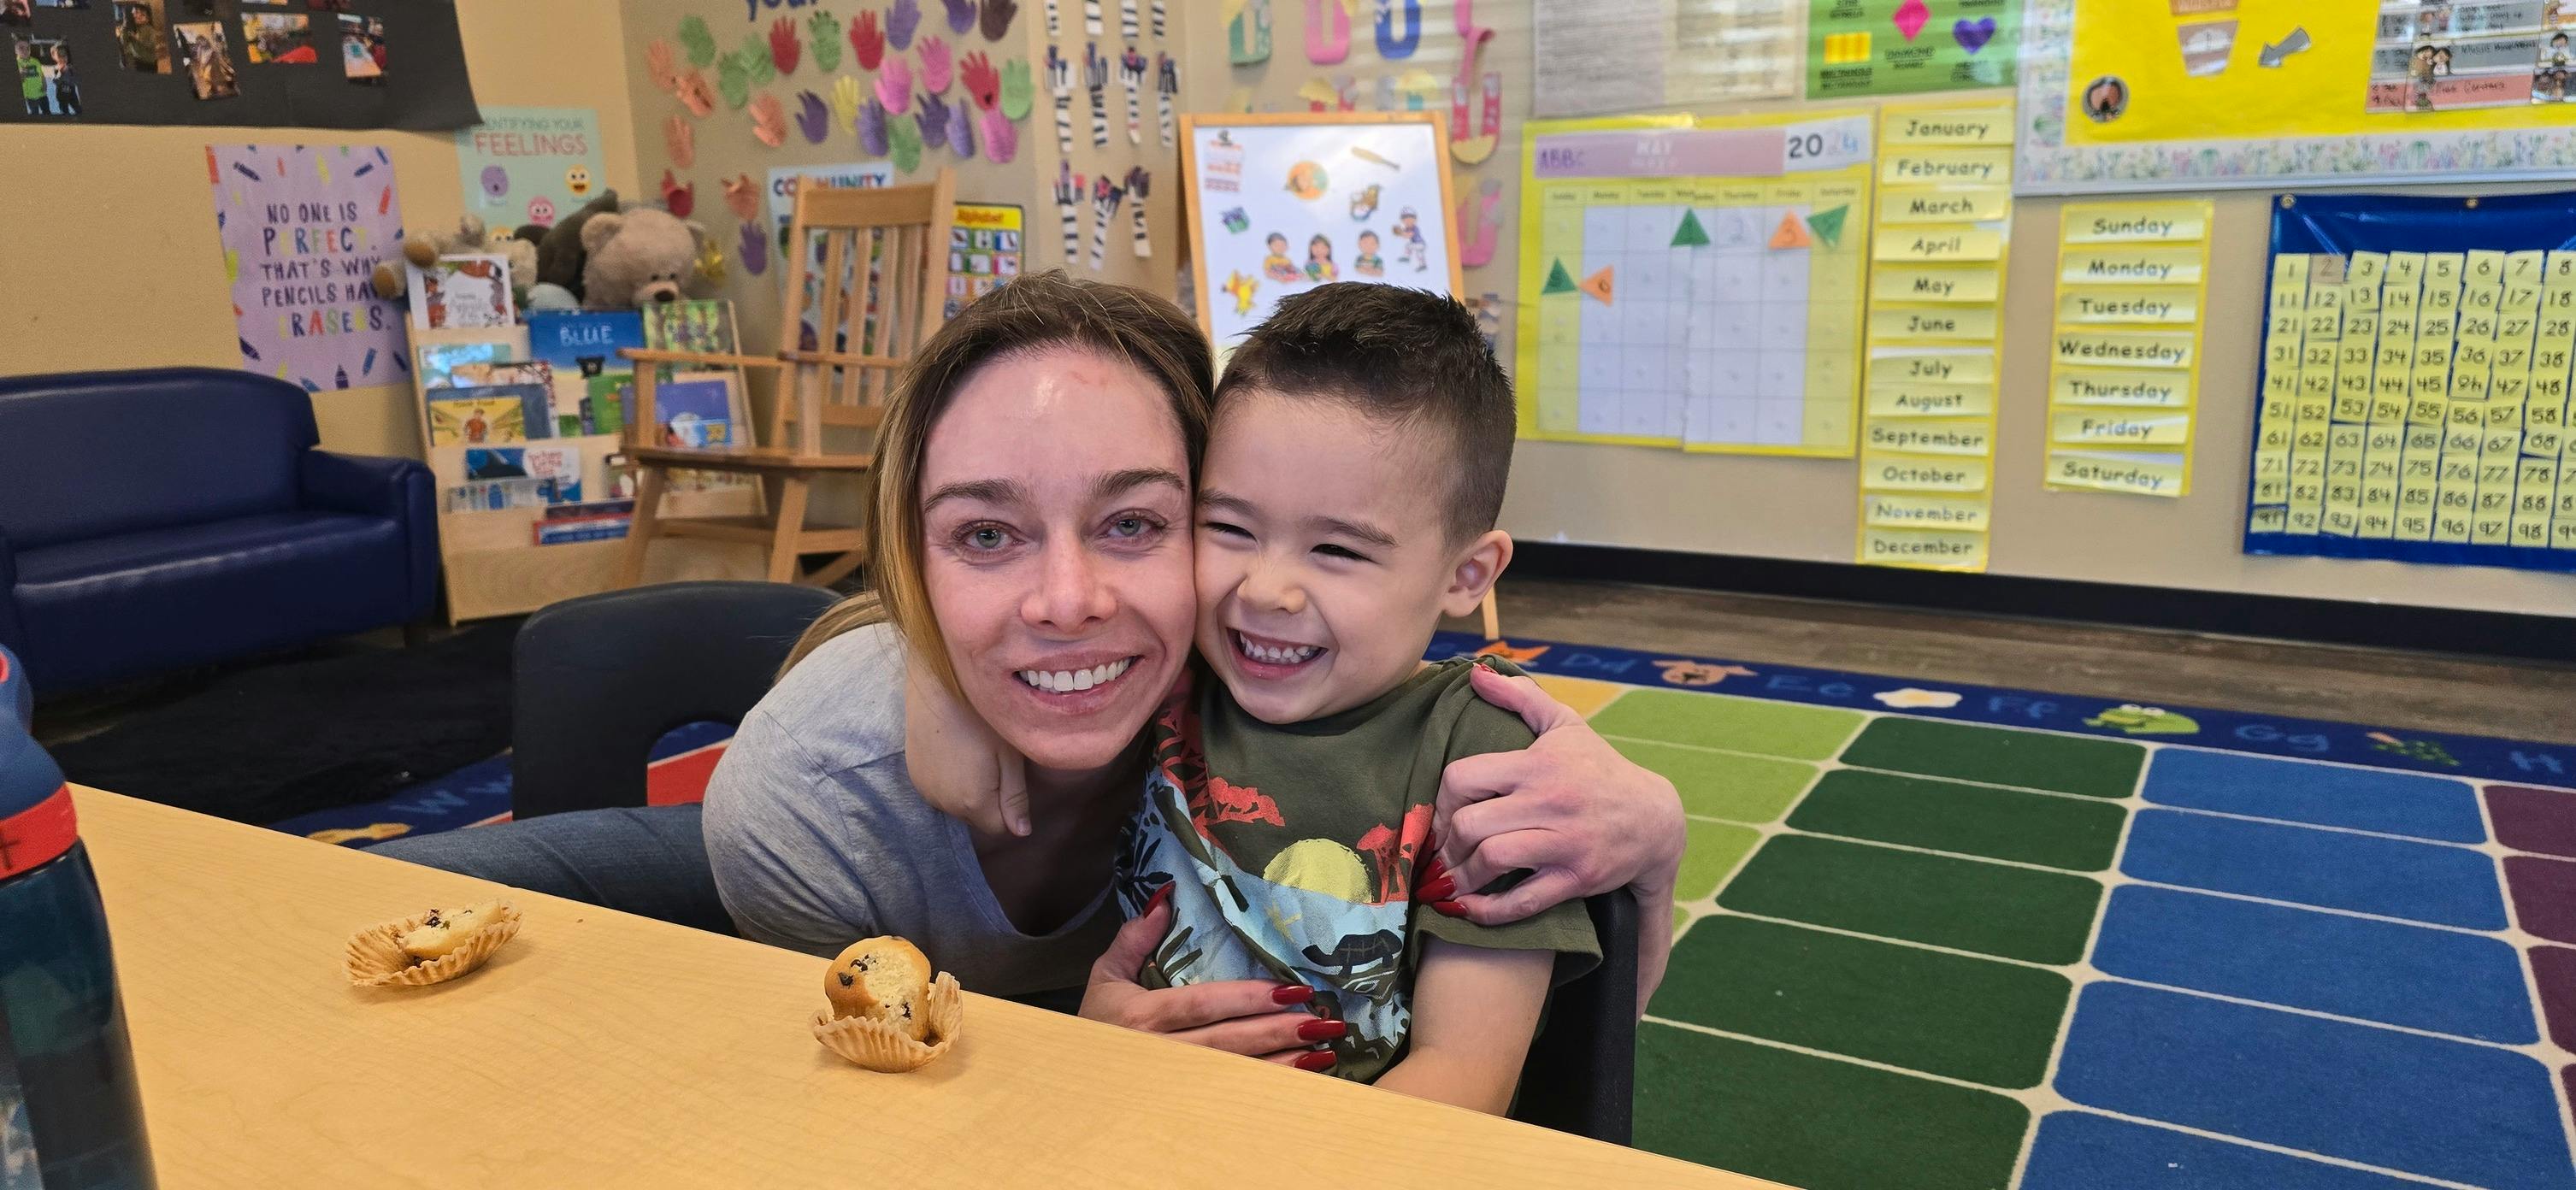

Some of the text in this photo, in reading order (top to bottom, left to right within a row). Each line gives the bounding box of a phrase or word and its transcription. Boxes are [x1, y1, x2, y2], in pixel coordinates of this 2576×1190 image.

[1905, 120, 1989, 139] January
[475, 133, 588, 156] FEELINGS
[1896, 157, 1994, 178] February
[267, 201, 357, 224] NO ONE IS
[1910, 197, 1973, 214] March
[2092, 215, 2173, 236] Sunday
[1911, 237, 1961, 255] April
[259, 258, 331, 280] THAT'S
[2087, 259, 2172, 280] Monday
[2288, 259, 2573, 278] 1 2 3 4 5 6 7 8
[262, 282, 336, 307] PENCILS
[1913, 278, 1954, 296] May
[2279, 287, 2574, 308] 11 12 13 14 15 16 17 18
[2079, 297, 2172, 318] Tuesday
[1907, 315, 1955, 332] June
[2278, 316, 2570, 336] 21 22 23 24 25 26 27 28
[559, 325, 614, 345] BLUE
[2059, 339, 2186, 363] Wednesday
[2274, 346, 2564, 368] 31 32 33 34 35 36 37 38
[1908, 360, 1953, 378] July
[2070, 380, 2172, 403] Thursday
[2272, 374, 2292, 389] 41
[2305, 376, 2330, 392] 42
[2342, 375, 2367, 391] 43
[2379, 377, 2403, 392] 44
[2417, 376, 2441, 392] 45
[2496, 378, 2522, 394] 47
[2535, 379, 2561, 395] 48
[1896, 394, 1963, 412] August
[2269, 400, 2557, 423] 51 52 53 54 55 56 57 58
[1872, 427, 1984, 446] September
[2081, 418, 2154, 439] Friday
[2267, 430, 2287, 445] 61
[2299, 429, 2323, 446] 62
[2335, 430, 2360, 447] 63
[2372, 433, 2396, 448] 64
[2411, 432, 2436, 448] 65
[2450, 433, 2475, 449] 66
[2487, 435, 2513, 452] 67
[2530, 432, 2557, 449] 68
[1883, 466, 1966, 483] October
[2063, 461, 2163, 490] Saturday
[2262, 458, 2283, 473] 71
[2293, 459, 2319, 475] 72
[2331, 459, 2356, 475] 73
[2368, 460, 2393, 477] 74
[2407, 459, 2432, 475] 75
[2444, 463, 2471, 479] 76
[2483, 465, 2510, 482] 77
[2523, 465, 2549, 483] 78
[2261, 482, 2281, 498] 81
[2294, 485, 2319, 501] 82
[2331, 485, 2355, 502] 83
[2367, 485, 2391, 503] 84
[2405, 487, 2429, 504] 85
[2443, 491, 2468, 508] 86
[2481, 492, 2507, 509] 87
[2521, 493, 2546, 511] 88
[1876, 504, 1977, 521] November
[2293, 512, 2316, 528] 92
[2365, 515, 2389, 530] 94
[2402, 515, 2426, 533] 95
[2442, 515, 2466, 534] 96
[2479, 520, 2503, 537] 97
[2519, 521, 2543, 540] 98
[1873, 539, 1973, 555] December
[2235, 723, 2331, 752] Gg
